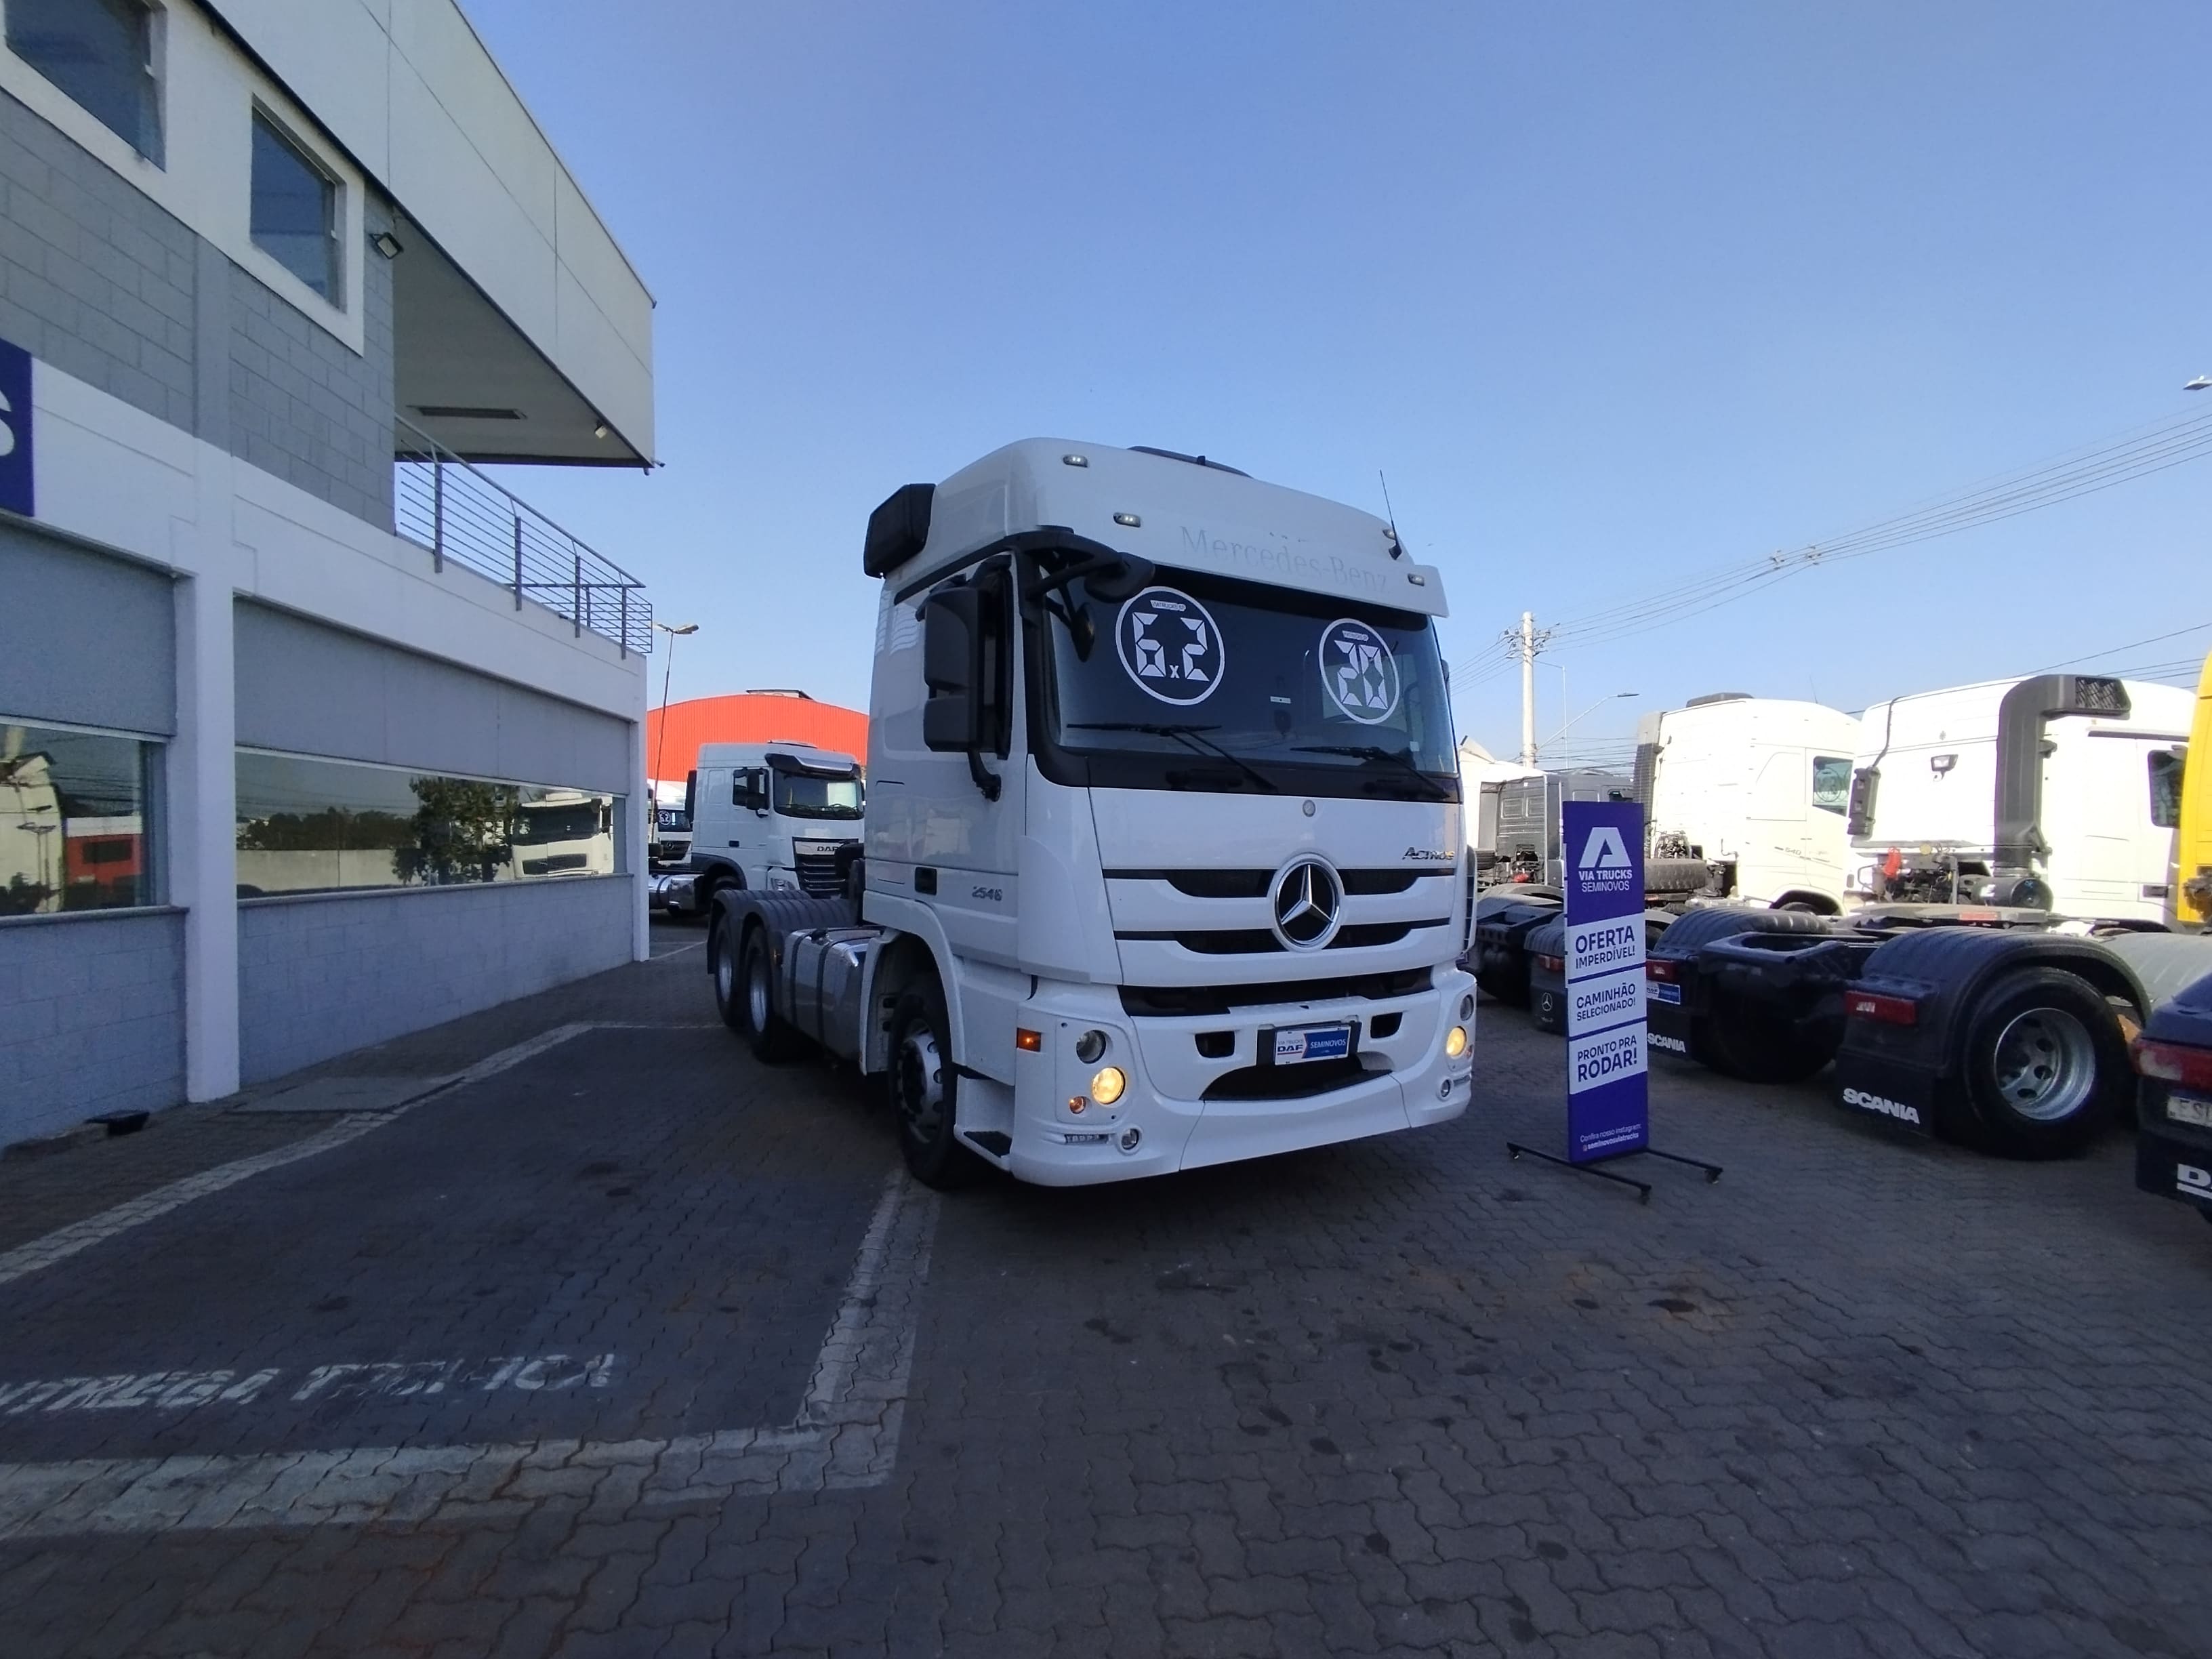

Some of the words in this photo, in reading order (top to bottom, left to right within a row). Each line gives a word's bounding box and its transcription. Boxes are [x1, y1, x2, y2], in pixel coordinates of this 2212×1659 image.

[1179, 525, 1387, 591] Mercedes-Benz
[1132, 612, 1210, 682] 6x2
[1334, 640, 1388, 710] 20
[1578, 870, 1593, 880] VIA
[1597, 869, 1633, 880] TRUCKS
[1582, 881, 1629, 893] SEMINOVOS
[1575, 926, 1635, 954] OFERTA
[1576, 945, 1635, 969] IMPERDÍVEL!
[1576, 983, 1635, 1008] CAMINHÃO
[1577, 997, 1635, 1021] SELECIONADO!
[1310, 1038, 1346, 1048] SEMINOVOS
[1578, 1040, 1616, 1061] PRONTO
[1619, 1035, 1637, 1049] PRA
[1647, 1033, 1686, 1052] SCANIA
[1578, 1047, 1637, 1082] RODAR!
[1843, 1088, 1920, 1124] SCANIA
